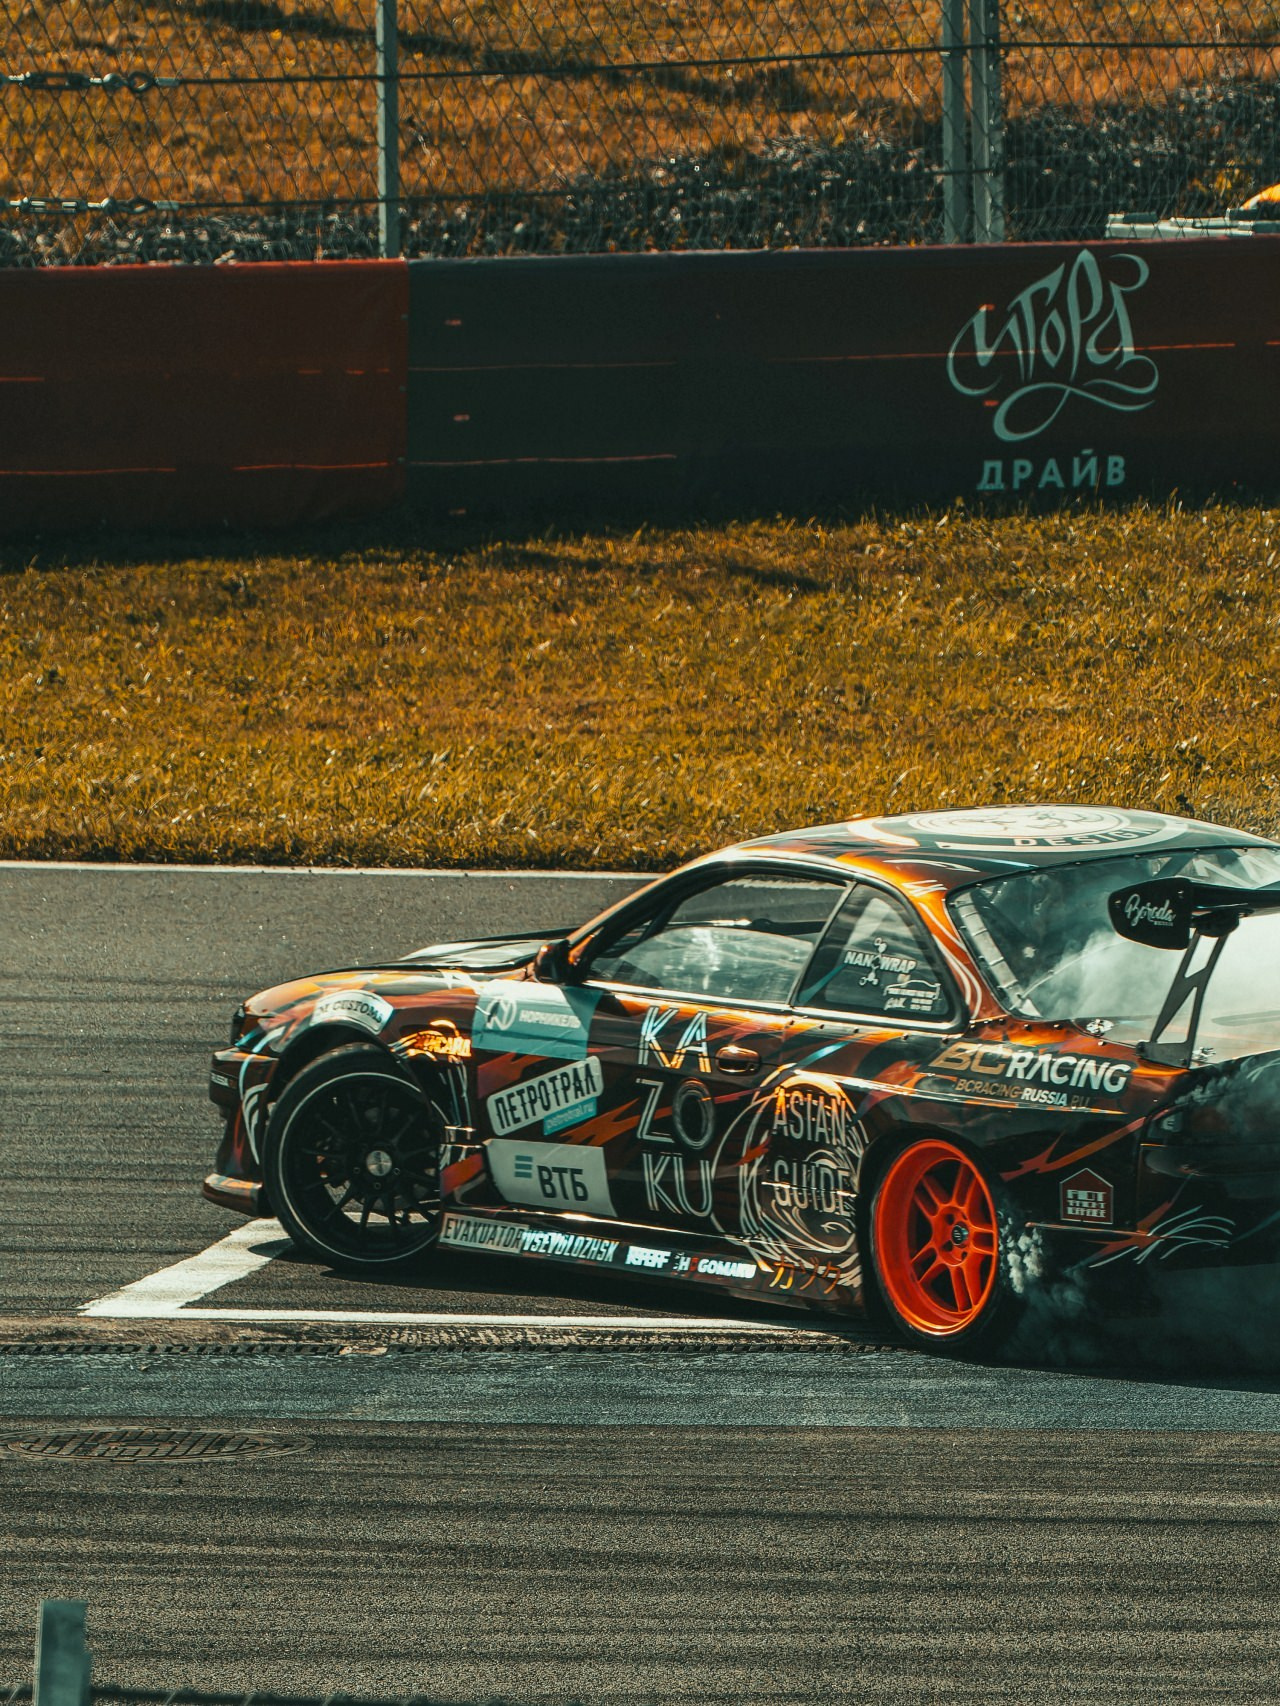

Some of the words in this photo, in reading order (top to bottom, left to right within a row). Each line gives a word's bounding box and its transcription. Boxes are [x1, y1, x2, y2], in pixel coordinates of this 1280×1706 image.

[976, 449, 1126, 490] ДРАЙВ
[880, 956, 917, 973] WRAP
[638, 1006, 711, 1073] KA
[493, 1063, 597, 1129] ПЕТРОТРАЛ
[636, 1078, 715, 1149] ZO
[773, 1087, 847, 1147] ASIAN
[537, 1165, 589, 1202] ВТБ
[642, 1152, 713, 1217] KU
[774, 1160, 850, 1216] GUIDE
[443, 1218, 525, 1250] EVAKUATOR
